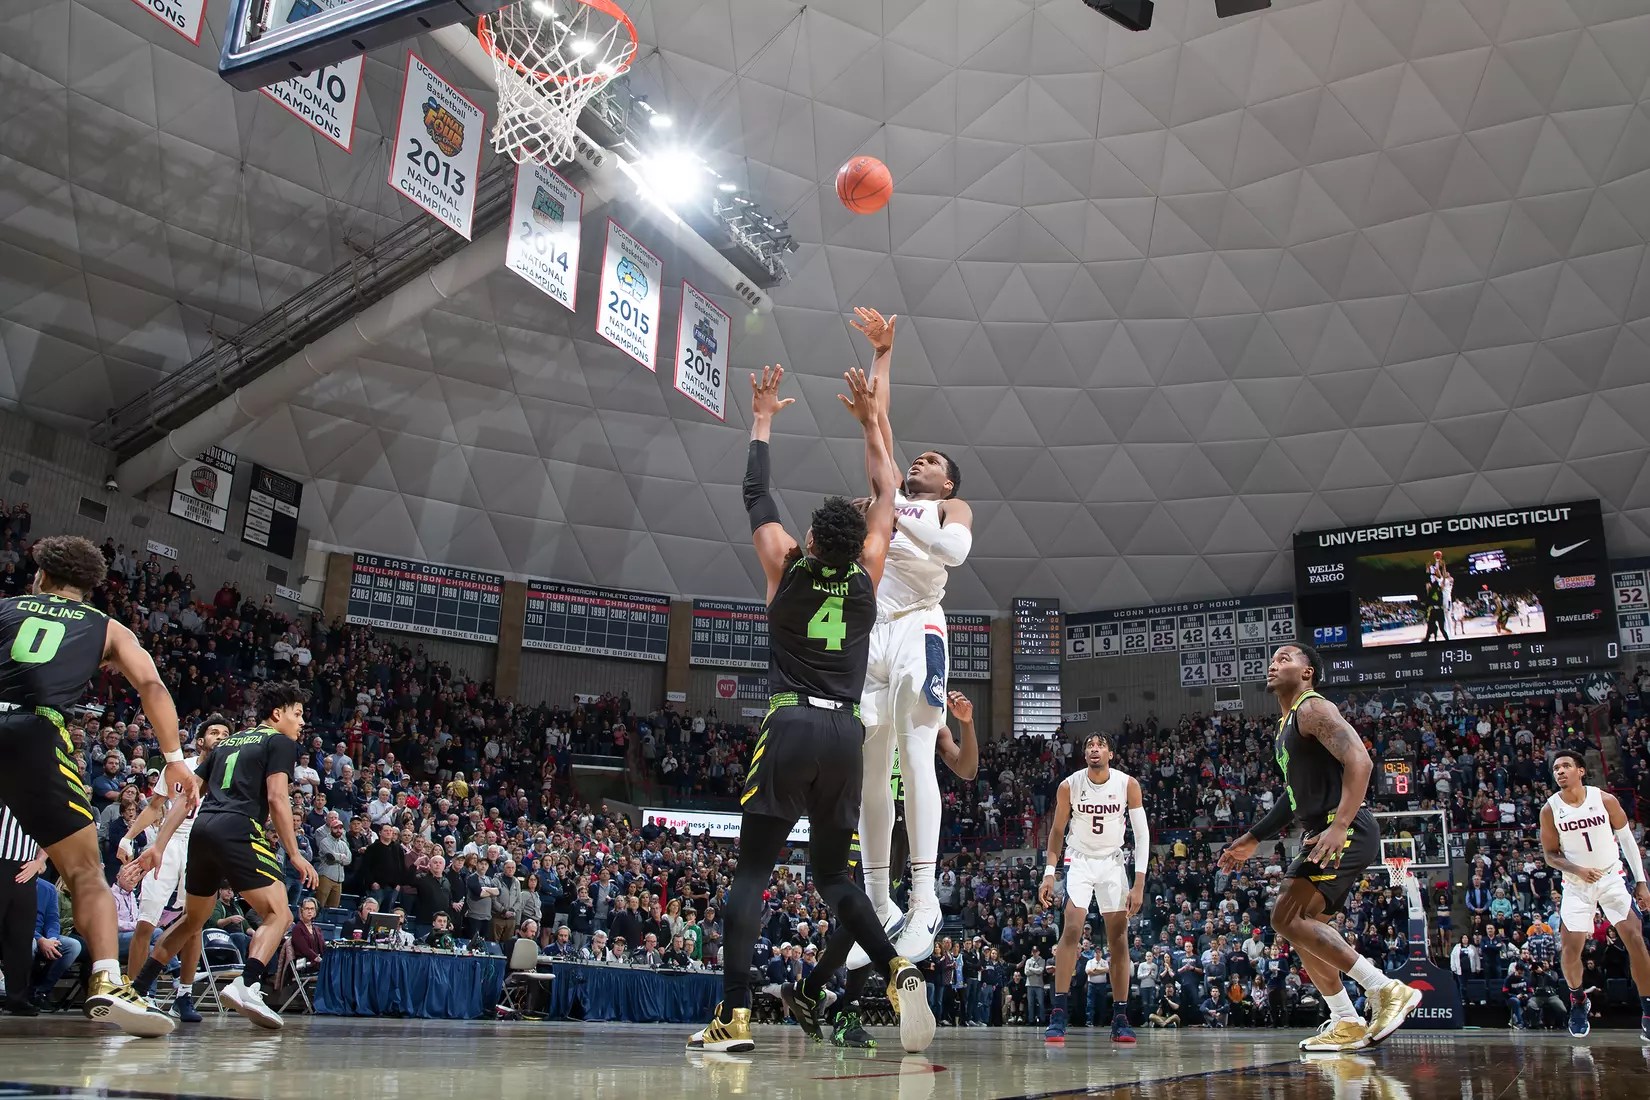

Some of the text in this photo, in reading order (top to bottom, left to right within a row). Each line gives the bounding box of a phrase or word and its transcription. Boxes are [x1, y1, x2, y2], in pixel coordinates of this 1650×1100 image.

[416, 62, 478, 117] UConn Women's
[426, 82, 466, 119] Basketball
[407, 137, 465, 197] 2013
[407, 166, 460, 212] NATIONAL
[534, 170, 567, 201] Basketball
[400, 179, 462, 229] CHAMPIONS
[520, 221, 569, 272] 2014
[621, 242, 650, 269] Basketball
[521, 248, 565, 285] NATIONAL
[516, 260, 568, 301] CHAMPIONS
[608, 290, 649, 335] 2015
[694, 302, 719, 325] Basketball
[609, 316, 647, 349] NATIONAL
[604, 326, 649, 363] CHAMPIONS
[684, 348, 721, 388] 2016
[685, 372, 718, 400] NATIONAL
[681, 381, 720, 414] CHAMPIONS
[1318, 508, 1571, 547] UNIVERSITY OF CONNECTICUT
[164, 547, 177, 559] 211
[357, 555, 500, 584] BIG EAST CONFERENCE
[1307, 563, 1344, 574] WELLS
[356, 565, 499, 592] REGULAR SEASON CHAMPIONS
[1309, 572, 1344, 584] FARGO
[1566, 580, 1595, 588] DONUTS
[288, 590, 301, 601] 212
[351, 588, 370, 600] 2003
[374, 591, 392, 603] 2005
[376, 576, 393, 588] 1994
[399, 580, 415, 591] 1995
[482, 593, 499, 604] 2002
[543, 584, 559, 592] EAST
[567, 587, 598, 596] AMERICAN
[599, 590, 628, 600] ATHLETIC
[629, 594, 667, 604] CONFERENCE
[1619, 588, 1644, 603] 52
[541, 592, 657, 611] TOURNAMENT CHAMPIONS
[700, 602, 734, 610] NATIONAL
[1113, 600, 1241, 618] UCONN HUSKIES OF HONOR
[16, 600, 86, 620] COLLINS
[611, 609, 627, 619] 2002
[630, 611, 646, 621] 2004
[651, 613, 666, 624] 2011
[1556, 612, 1596, 622] TRAVELERS
[527, 614, 543, 624] 2016
[695, 618, 710, 628] 1955
[715, 620, 729, 630] 1974
[807, 596, 847, 650] 4
[350, 616, 494, 641] CONNECTICUT MEN'S BASKETBALL
[1183, 629, 1203, 642] 42
[1211, 626, 1232, 640] 44
[1271, 621, 1292, 635] 42
[1314, 626, 1344, 638] CBS
[1629, 628, 1643, 643] 15
[11, 616, 67, 663] 0
[1103, 638, 1110, 650] 9
[1125, 635, 1145, 648] 22
[1153, 632, 1174, 646] 25
[526, 641, 662, 660] CONNECTICUT MEN'S BASKETBALL
[1441, 650, 1472, 662] 19:36
[1481, 644, 1499, 652] BONUS
[1607, 642, 1617, 659] 0
[694, 658, 747, 667] CONNECTICUT
[1215, 663, 1231, 677] 13
[1244, 661, 1263, 675] 22
[1500, 661, 1511, 669] FLS
[1514, 660, 1520, 669] 0
[1538, 658, 1550, 666] SEC
[1552, 658, 1557, 666] 3
[1566, 656, 1582, 664] FULL
[1184, 665, 1205, 680] 24
[1373, 672, 1386, 680] SEC
[720, 683, 734, 692] NIT
[1467, 685, 1486, 693] Harry
[1494, 682, 1520, 692] Gampel
[1521, 680, 1546, 688] Pavilion
[1476, 691, 1510, 700] Basketball
[1511, 690, 1535, 699] Capital
[1557, 686, 1577, 694] World
[220, 750, 240, 790] 1
[1384, 762, 1410, 774] 19:36
[1396, 775, 1408, 794] 8
[1077, 804, 1120, 814] UCONN
[723, 822, 741, 832] plan
[1092, 816, 1104, 835] 5
[1558, 814, 1606, 832] UCONN
[1581, 832, 1593, 852] 1
[1407, 1008, 1453, 1018] VELERS
